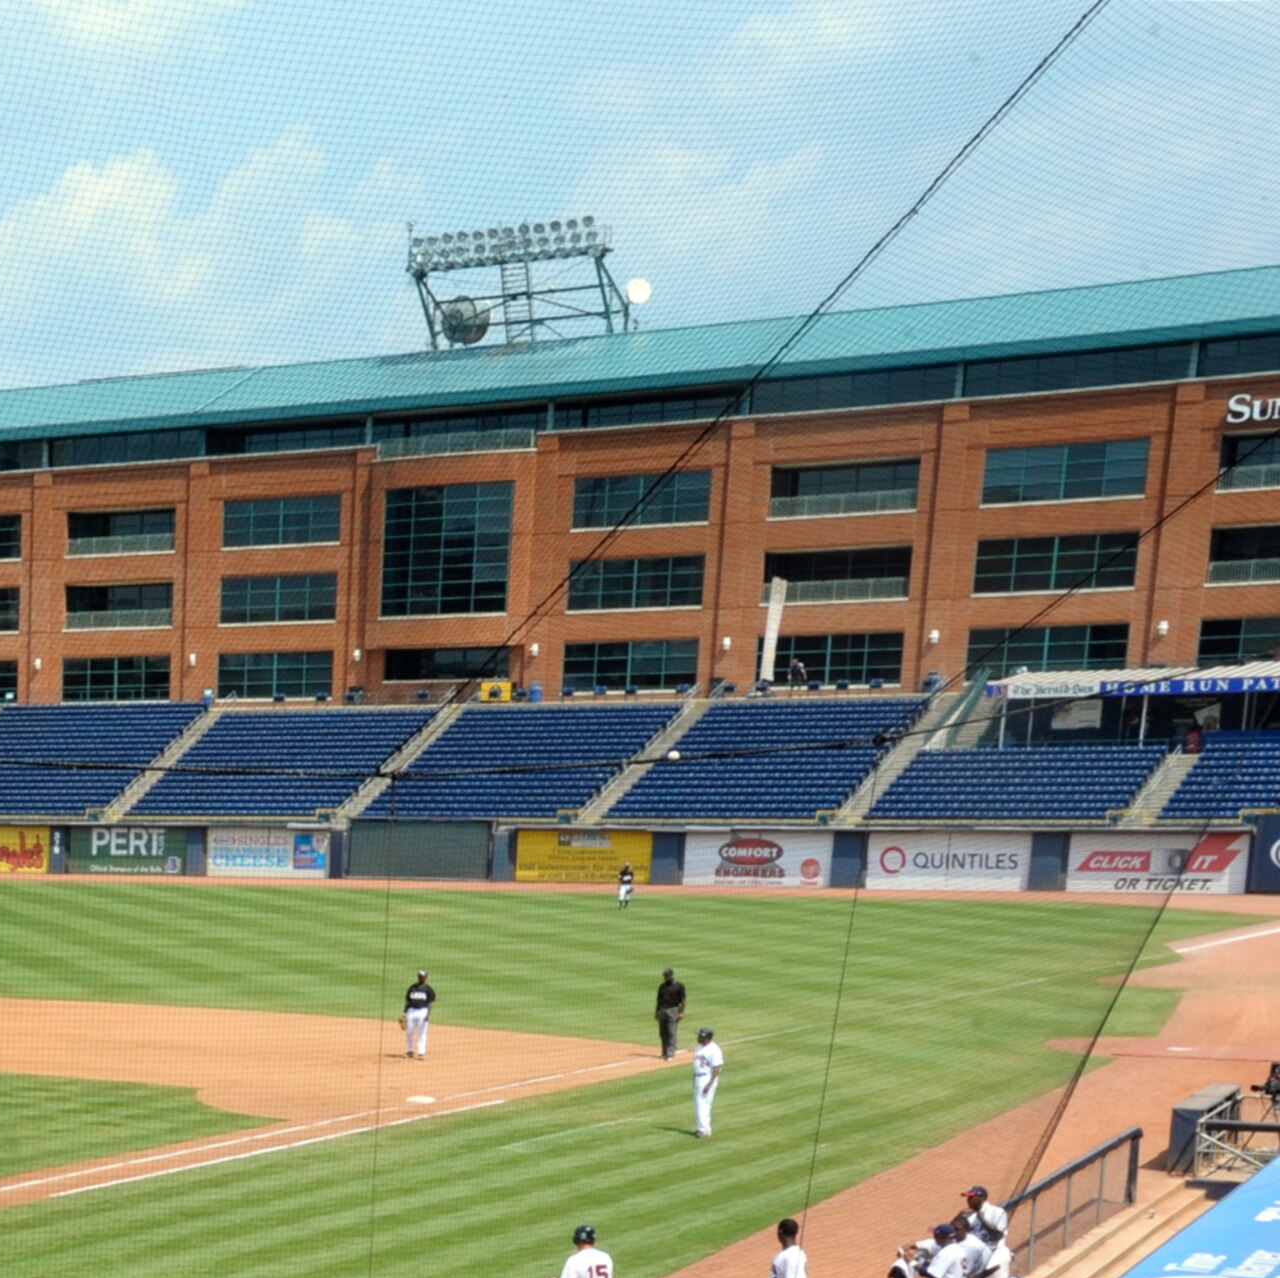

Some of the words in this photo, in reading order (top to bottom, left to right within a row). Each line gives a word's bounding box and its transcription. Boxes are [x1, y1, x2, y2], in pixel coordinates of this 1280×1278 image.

[1013, 684, 1033, 695] The
[1106, 681, 1171, 694] HOME
[1183, 679, 1230, 692] RUN
[91, 827, 165, 857] PERT
[237, 835, 290, 846] SINGLES
[721, 846, 778, 858] COMFORT
[212, 855, 289, 868] CHEESE
[913, 851, 1019, 871] QUINTILES
[1088, 856, 1146, 870] CLICK
[1191, 856, 1216, 869] IT
[715, 867, 786, 878] ENGINEERS
[1114, 878, 1141, 890] OR
[1145, 878, 1212, 891] TICKET.
[1163, 1253, 1228, 1274] Time
